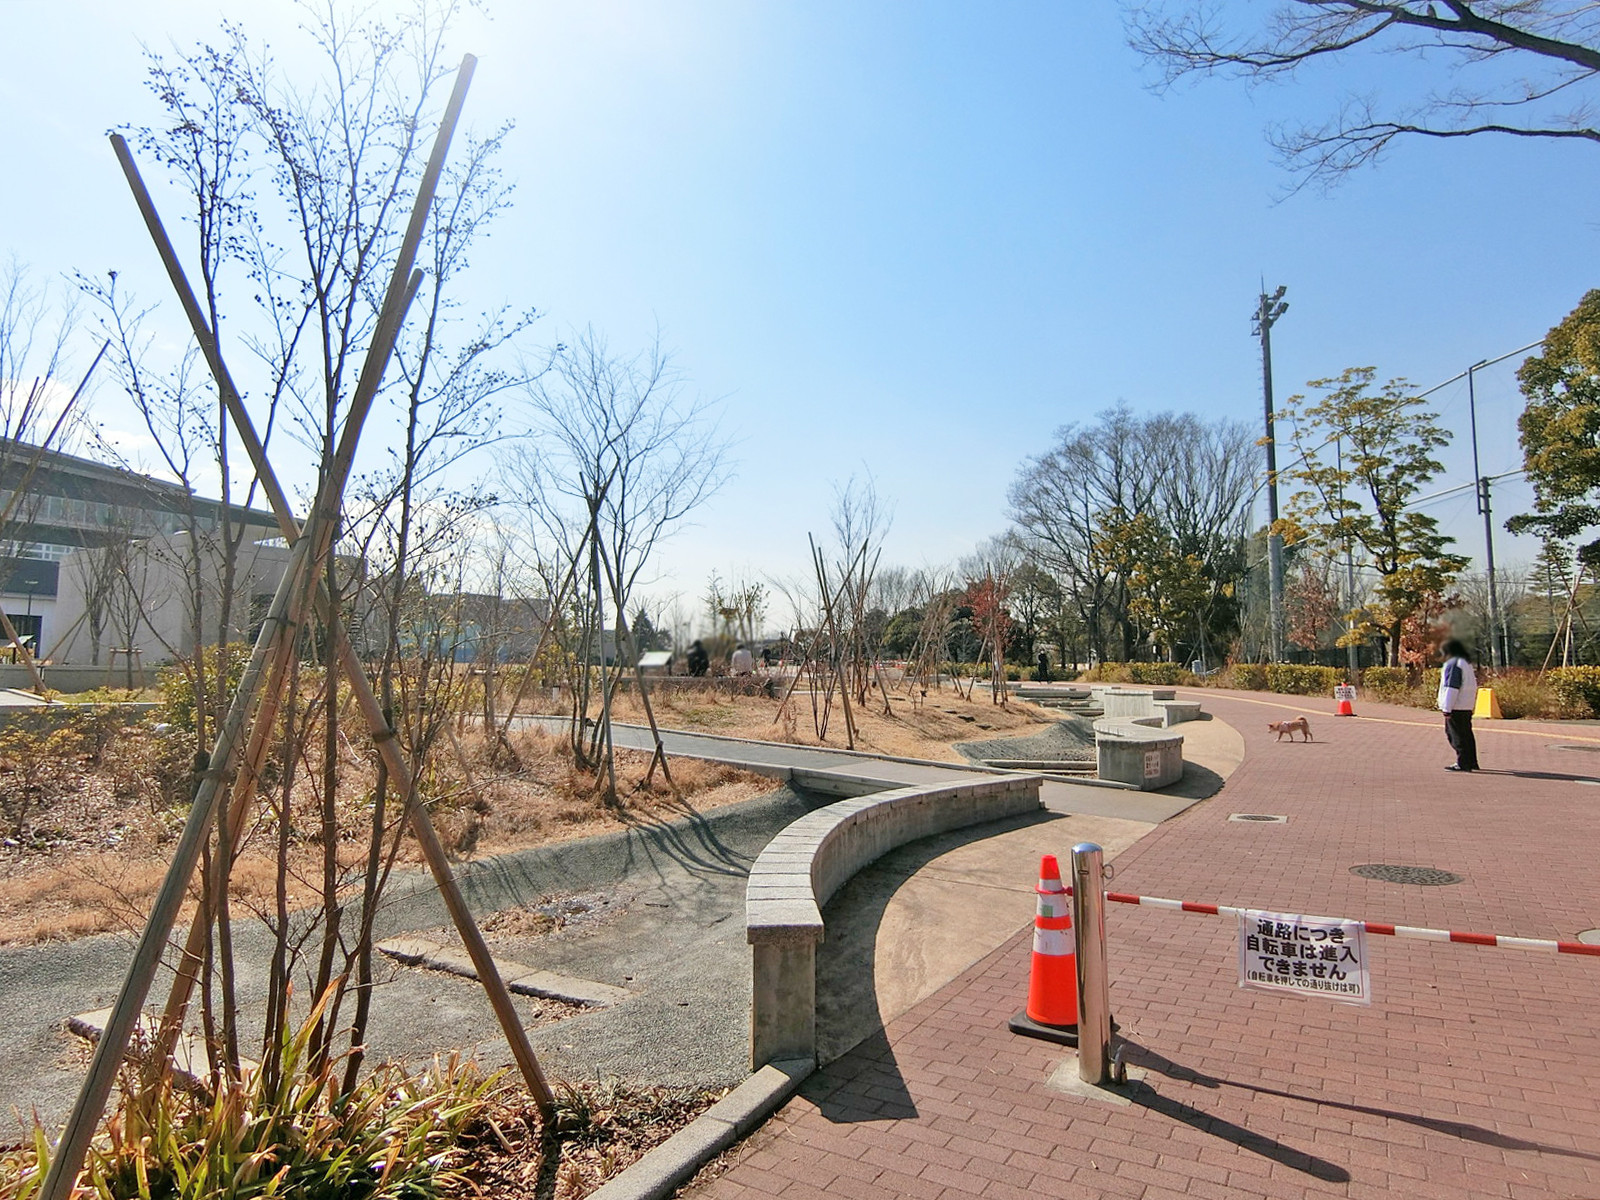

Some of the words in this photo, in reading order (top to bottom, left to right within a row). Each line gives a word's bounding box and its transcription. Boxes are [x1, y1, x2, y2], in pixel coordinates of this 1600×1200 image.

[1257, 919, 1345, 944] 通路につき
[1246, 934, 1359, 964] 自転車は進入
[1258, 955, 1347, 981] できません
